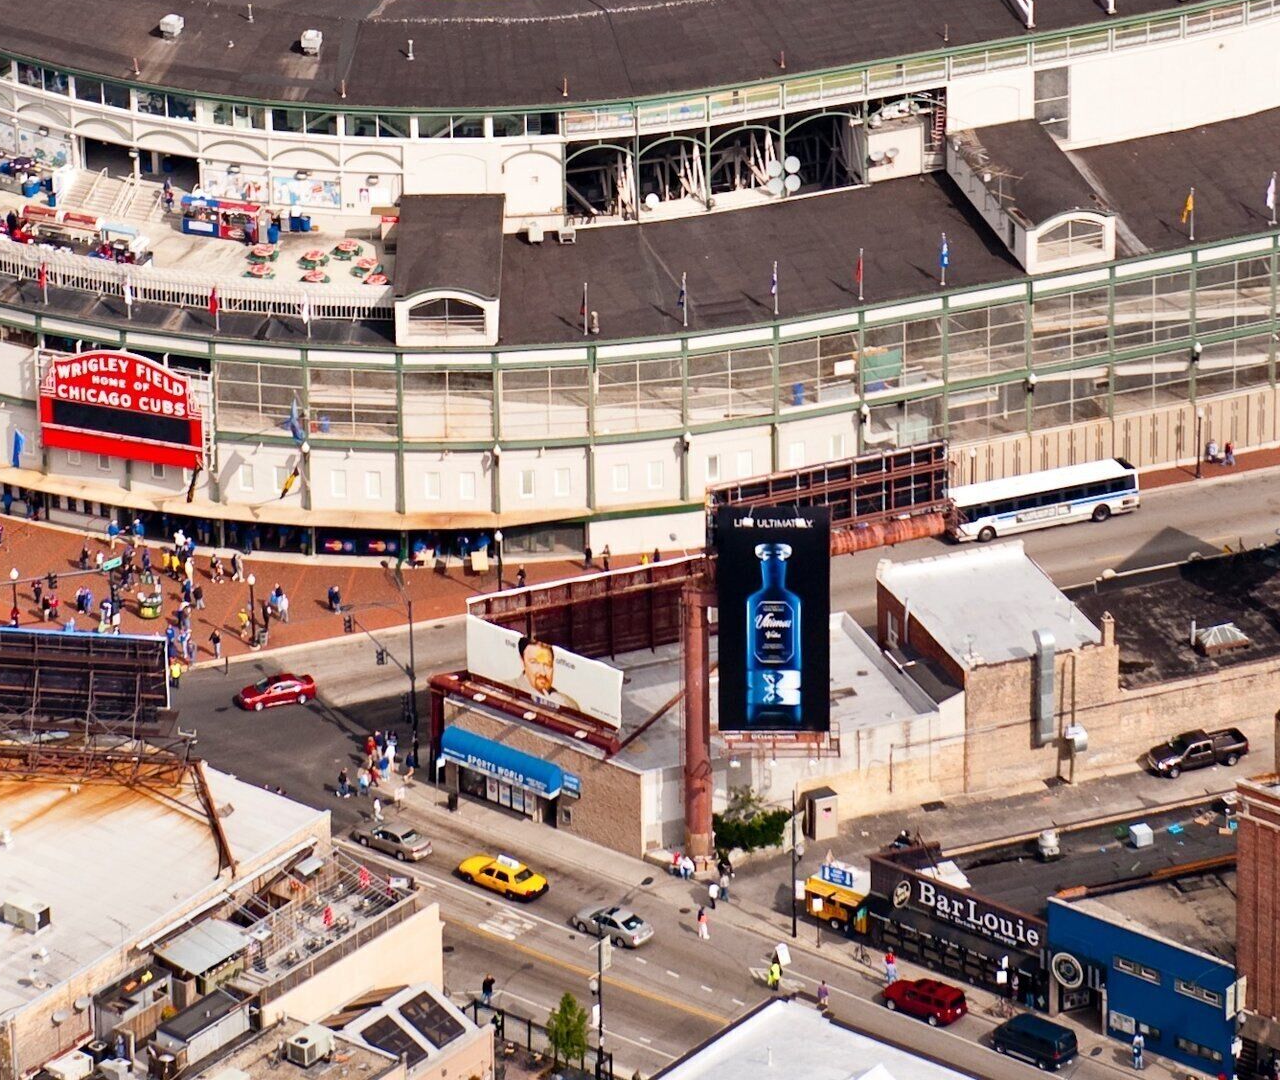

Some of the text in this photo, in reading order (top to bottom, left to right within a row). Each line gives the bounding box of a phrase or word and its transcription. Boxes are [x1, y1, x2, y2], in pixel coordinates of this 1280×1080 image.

[56, 357, 185, 396] WRIGLEY FIELD
[91, 375, 150, 392] HOME OF
[57, 384, 186, 416] CHICAGO CUBS
[505, 639, 576, 670] the office
[467, 754, 524, 782] SPORTS WORLD
[918, 880, 964, 916] Bar
[967, 899, 1040, 947] Louie
